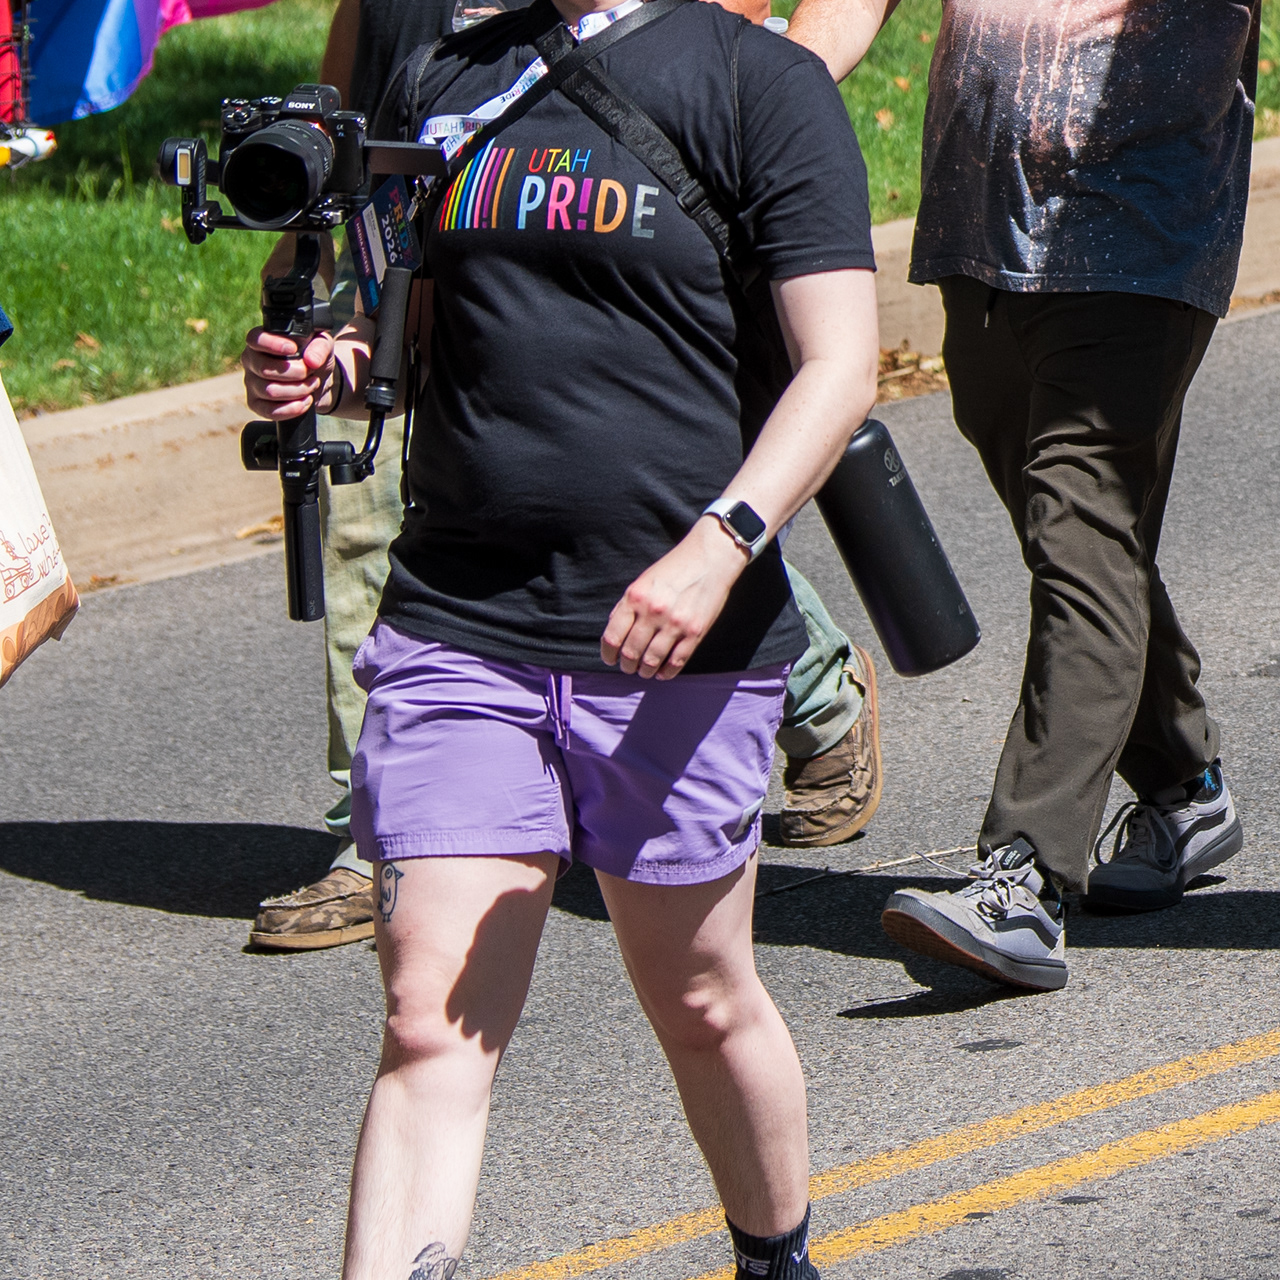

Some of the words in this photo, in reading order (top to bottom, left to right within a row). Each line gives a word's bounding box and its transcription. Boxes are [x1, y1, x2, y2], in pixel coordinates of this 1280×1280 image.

[287, 101, 316, 110] SONY
[528, 148, 592, 173] UTAH
[381, 214, 398, 264] 2026
